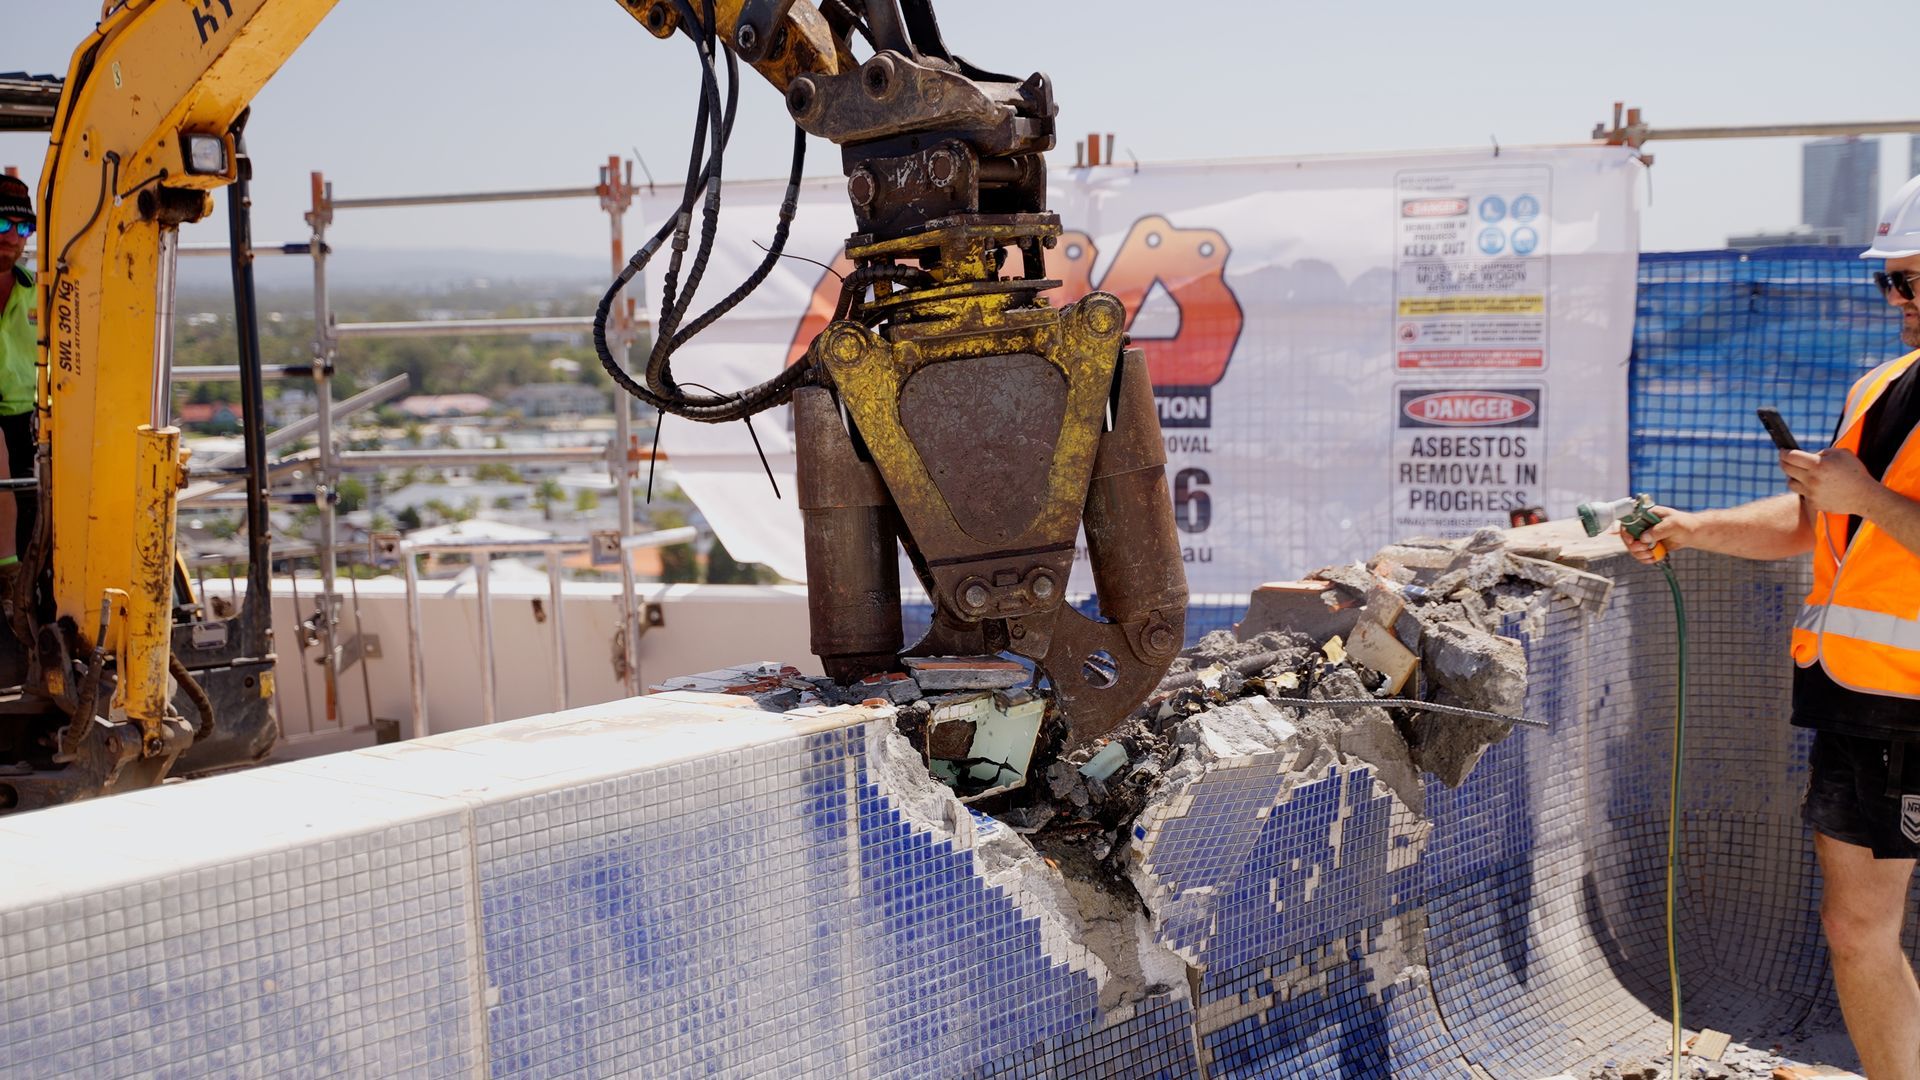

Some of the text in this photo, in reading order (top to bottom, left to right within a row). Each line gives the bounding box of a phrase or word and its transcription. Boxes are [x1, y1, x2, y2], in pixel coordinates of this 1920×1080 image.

[58, 280, 74, 372] SWL 310 Kg
[1424, 399, 1514, 419] DANGER
[1163, 436, 1212, 453] OVAL
[1411, 437, 1527, 458] ASBESTOS
[1400, 463, 1537, 485] REMOVAL IN
[1409, 490, 1527, 512] PROGRESS
